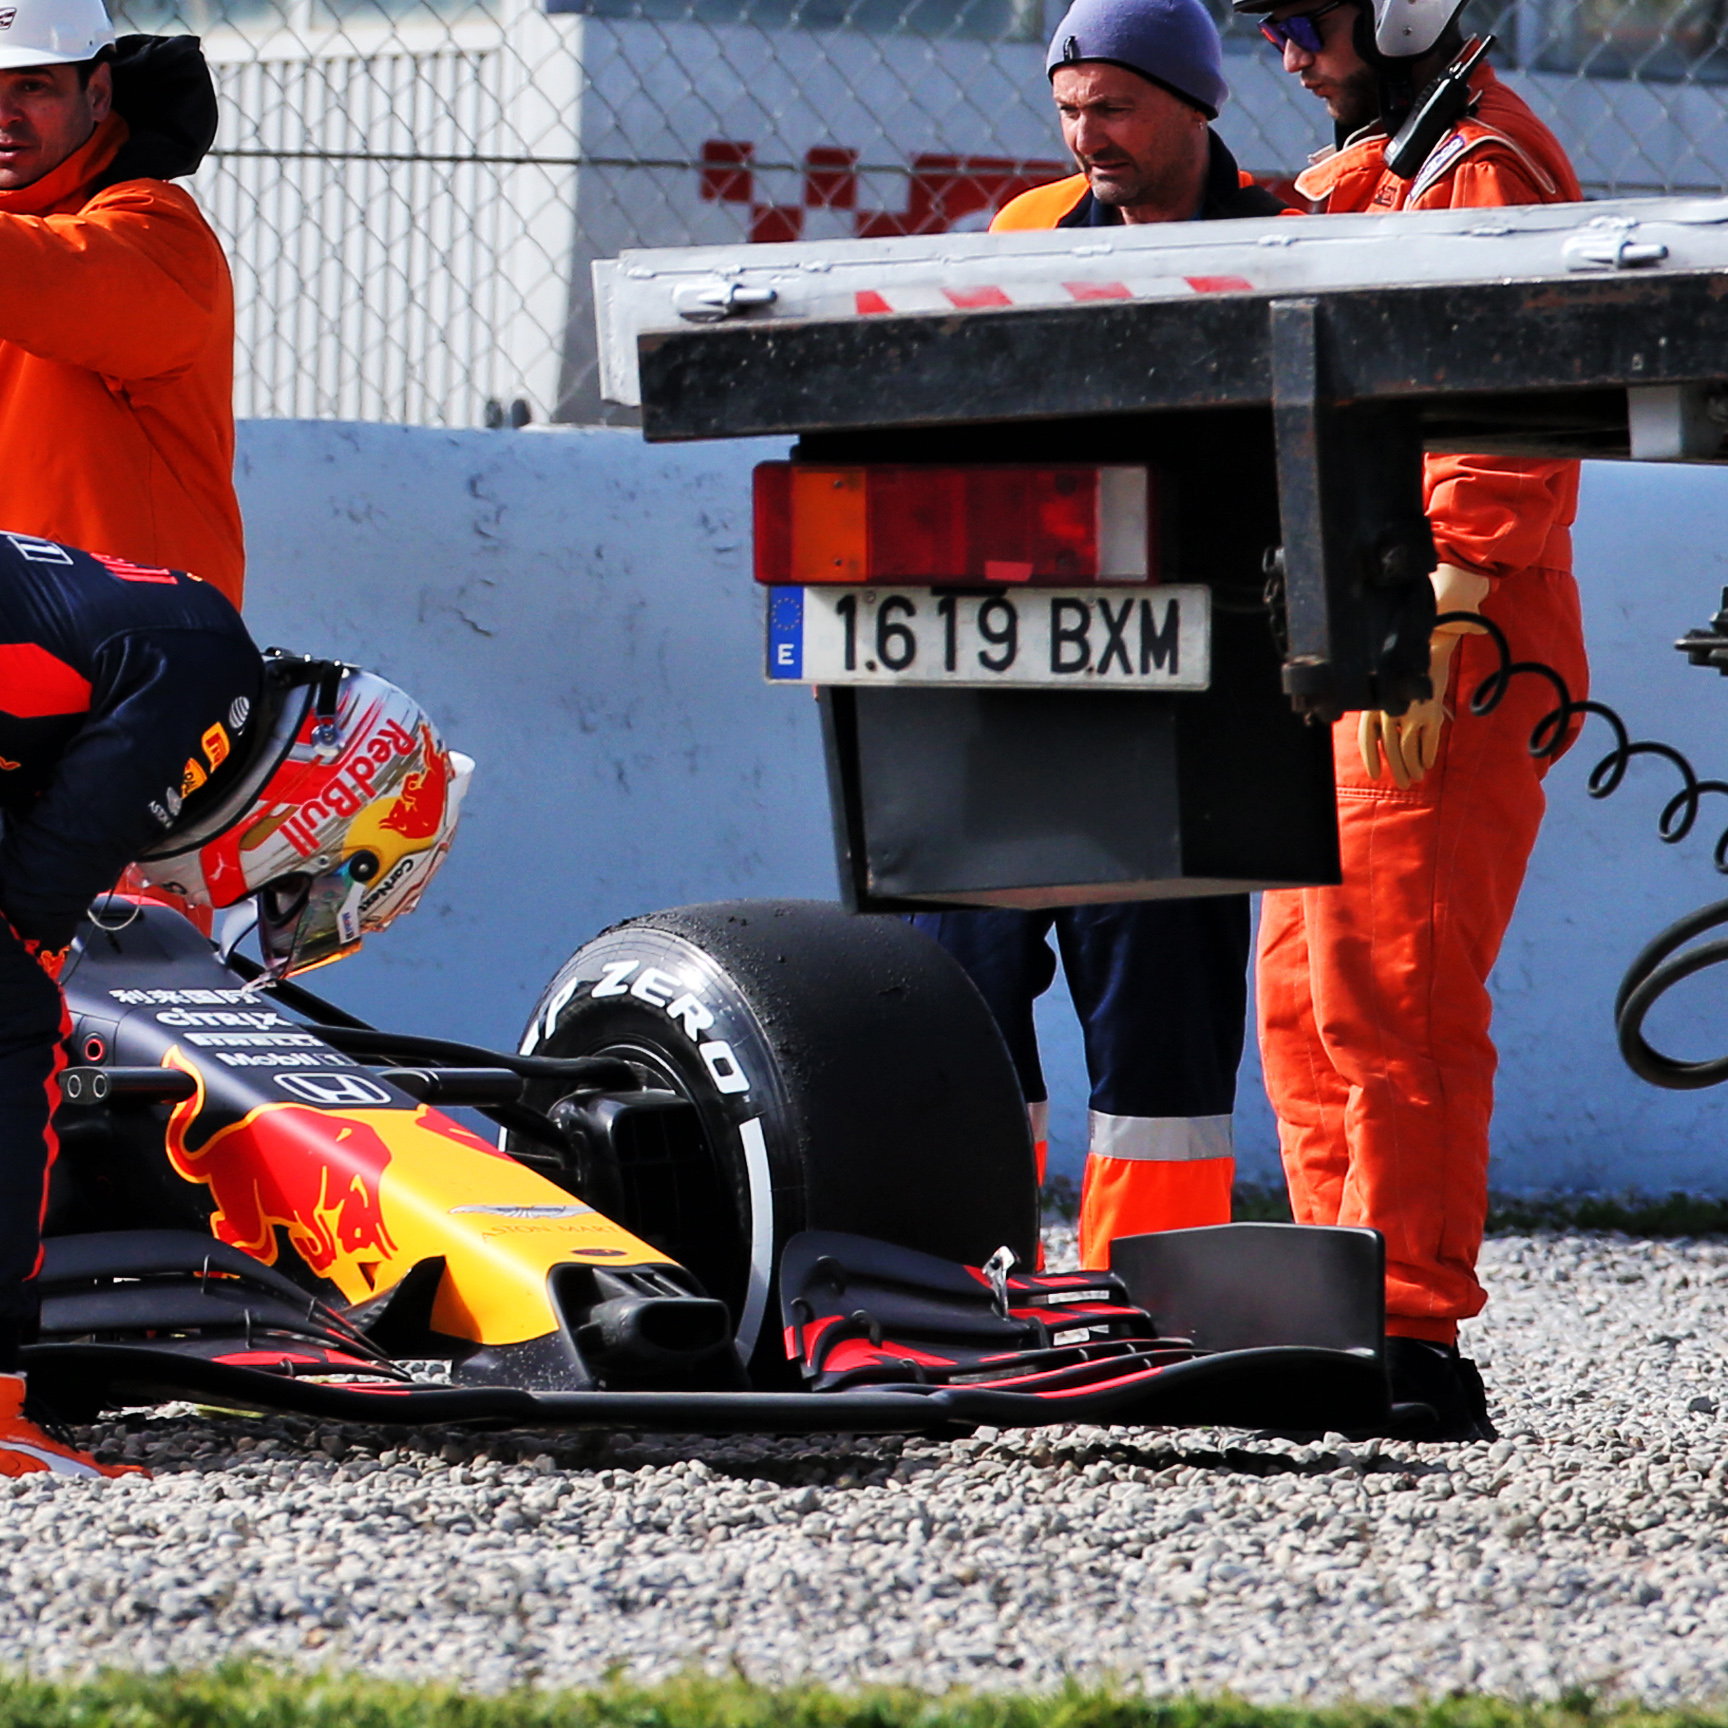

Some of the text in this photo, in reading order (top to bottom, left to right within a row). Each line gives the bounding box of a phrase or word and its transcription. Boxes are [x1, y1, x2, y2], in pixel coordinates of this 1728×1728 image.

[777, 643, 795, 665] E
[835, 594, 1180, 675] 1619 BXM
[278, 718, 417, 858] Red Bull
[183, 1032, 325, 1047] PIRELLI
[545, 960, 751, 1095] P ZERO
[215, 1052, 321, 1067] Mobil
